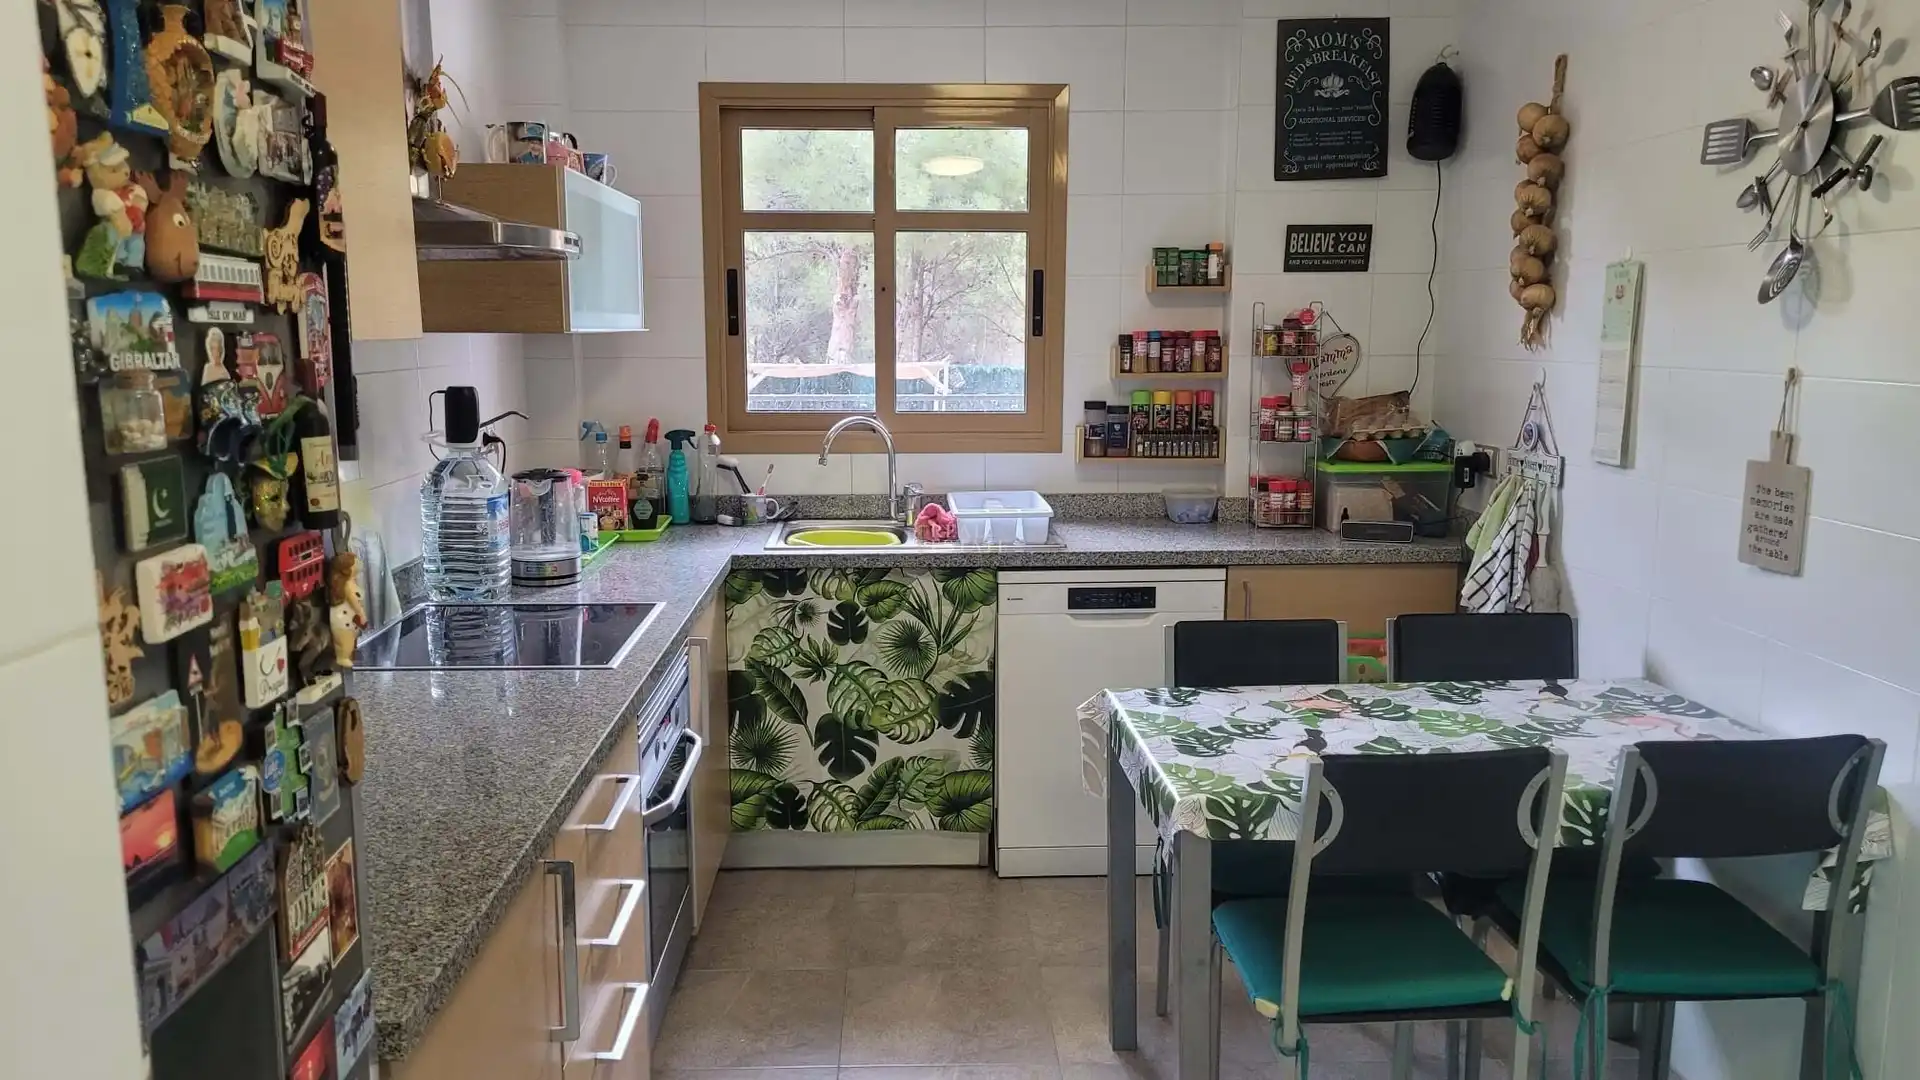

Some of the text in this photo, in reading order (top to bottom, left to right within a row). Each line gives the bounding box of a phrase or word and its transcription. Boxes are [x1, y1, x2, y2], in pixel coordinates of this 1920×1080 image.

[1306, 31, 1362, 52] MOM'S
[1299, 115, 1367, 124] ADDITIONAL SERVICES
[1289, 231, 1367, 253] BELIEVE YOU
[1337, 243, 1366, 253] CAN
[109, 351, 181, 372] GIBRALTAR
[1542, 459, 1557, 474] Home
[592, 495, 621, 503] NYcoffee
[1755, 484, 1795, 500] The best
[1750, 496, 1796, 514] memories
[1754, 511, 1794, 527] are made
[1746, 523, 1789, 540] gathered
[1748, 543, 1789, 562] the table
